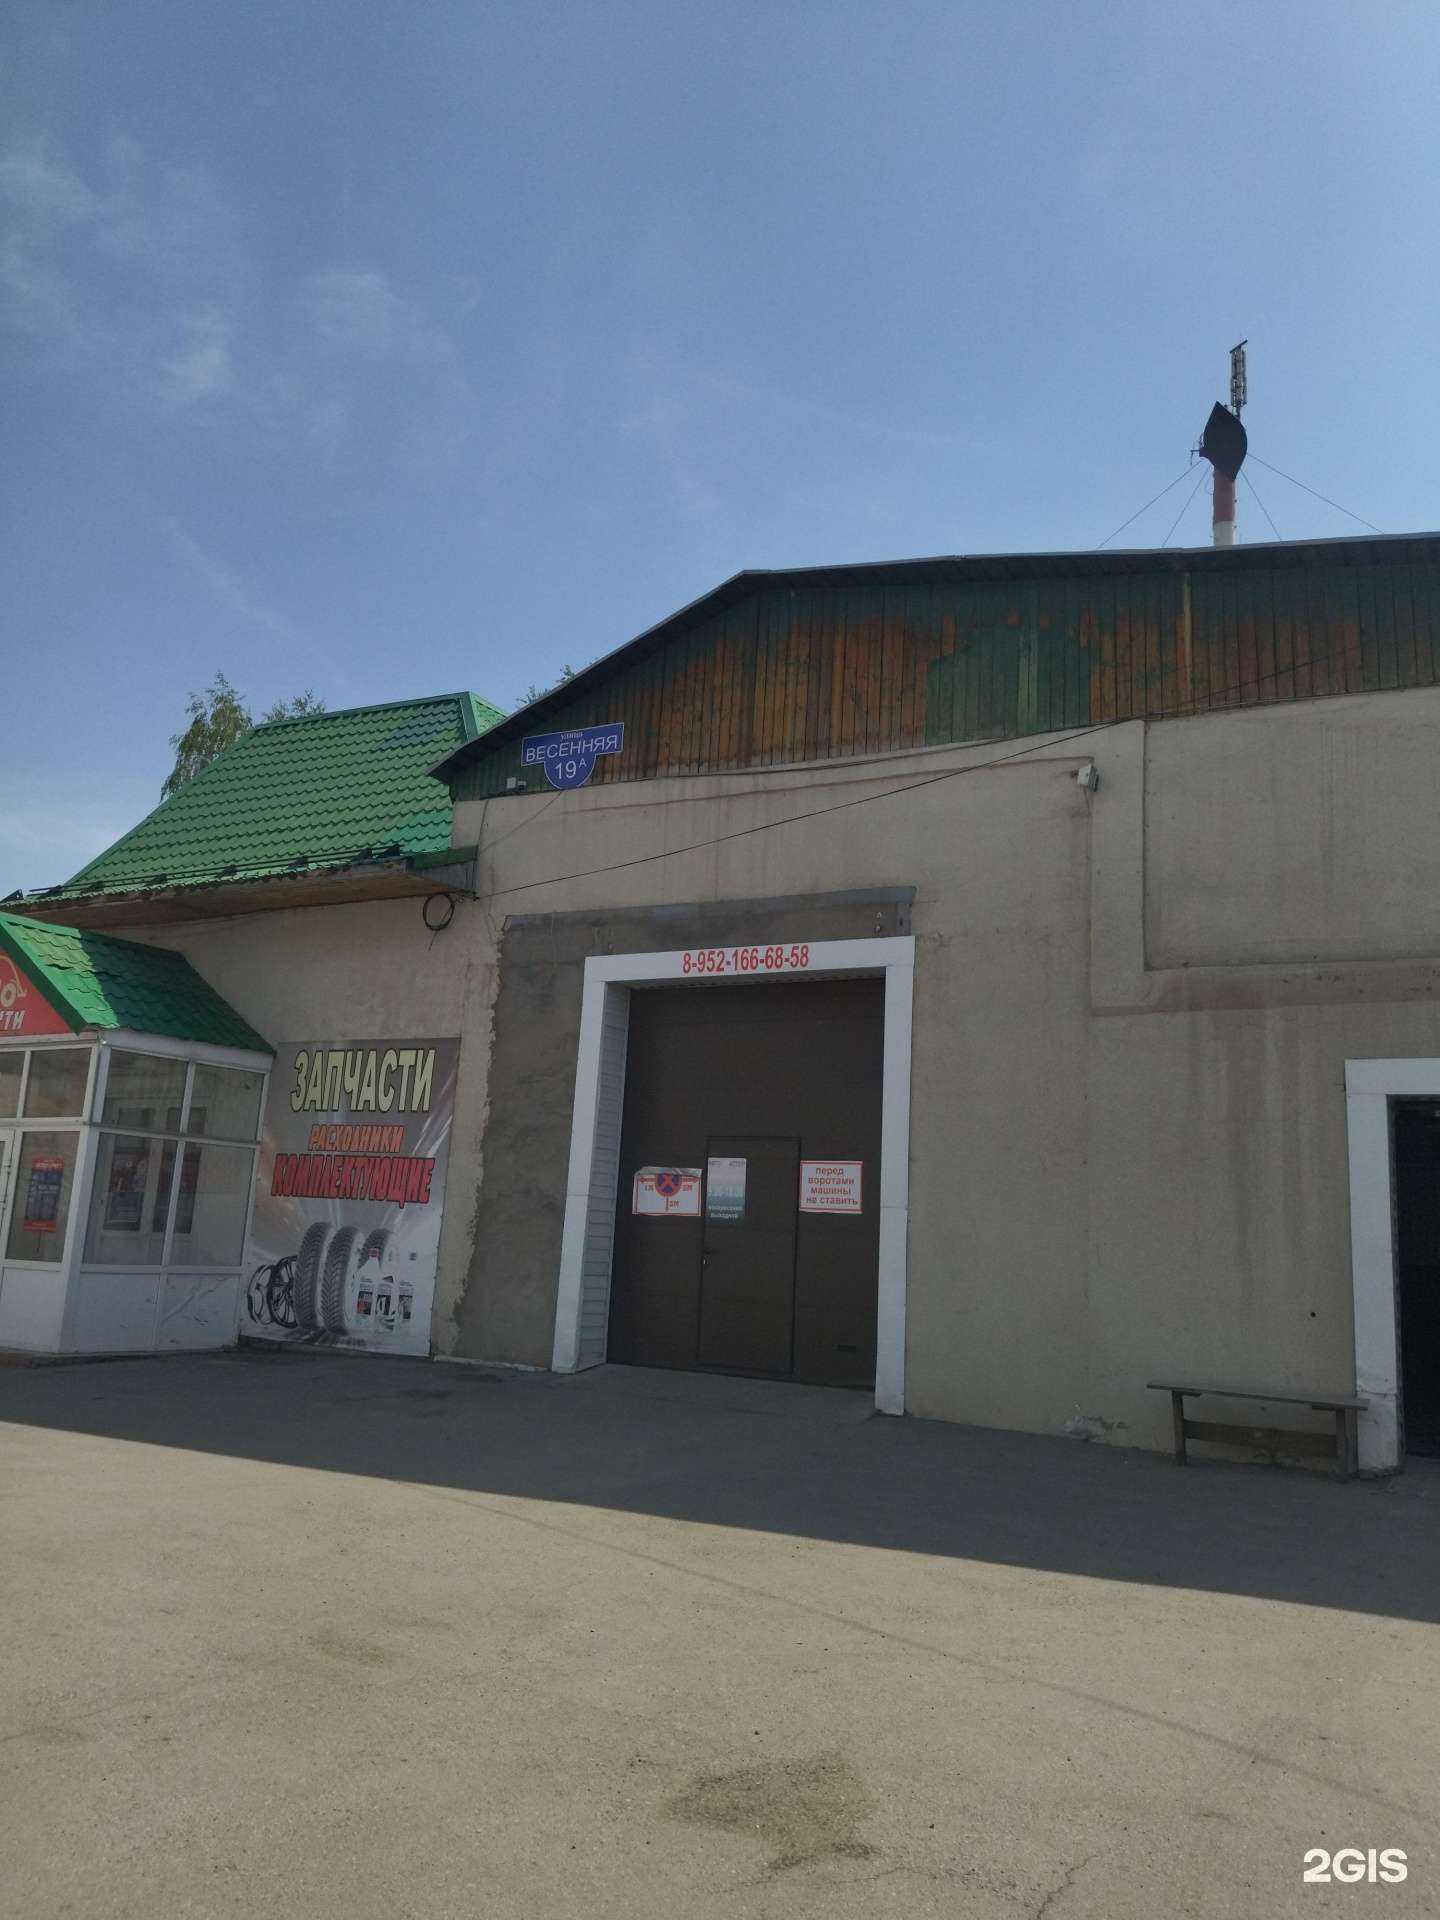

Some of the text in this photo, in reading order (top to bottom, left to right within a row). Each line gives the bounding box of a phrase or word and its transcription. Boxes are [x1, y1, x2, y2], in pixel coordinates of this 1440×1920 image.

[526, 735, 617, 762] ВЕСЕННЯЯ
[682, 944, 809, 974] 8-952-166-68-58
[290, 1049, 436, 1112] ЗАПЧАСТИ
[271, 1153, 435, 1209] КОМПЛЕКТУЮЩИЕ
[808, 1177, 855, 1186] воротами
[815, 1167, 844, 1176] перед
[810, 1187, 851, 1195] машины
